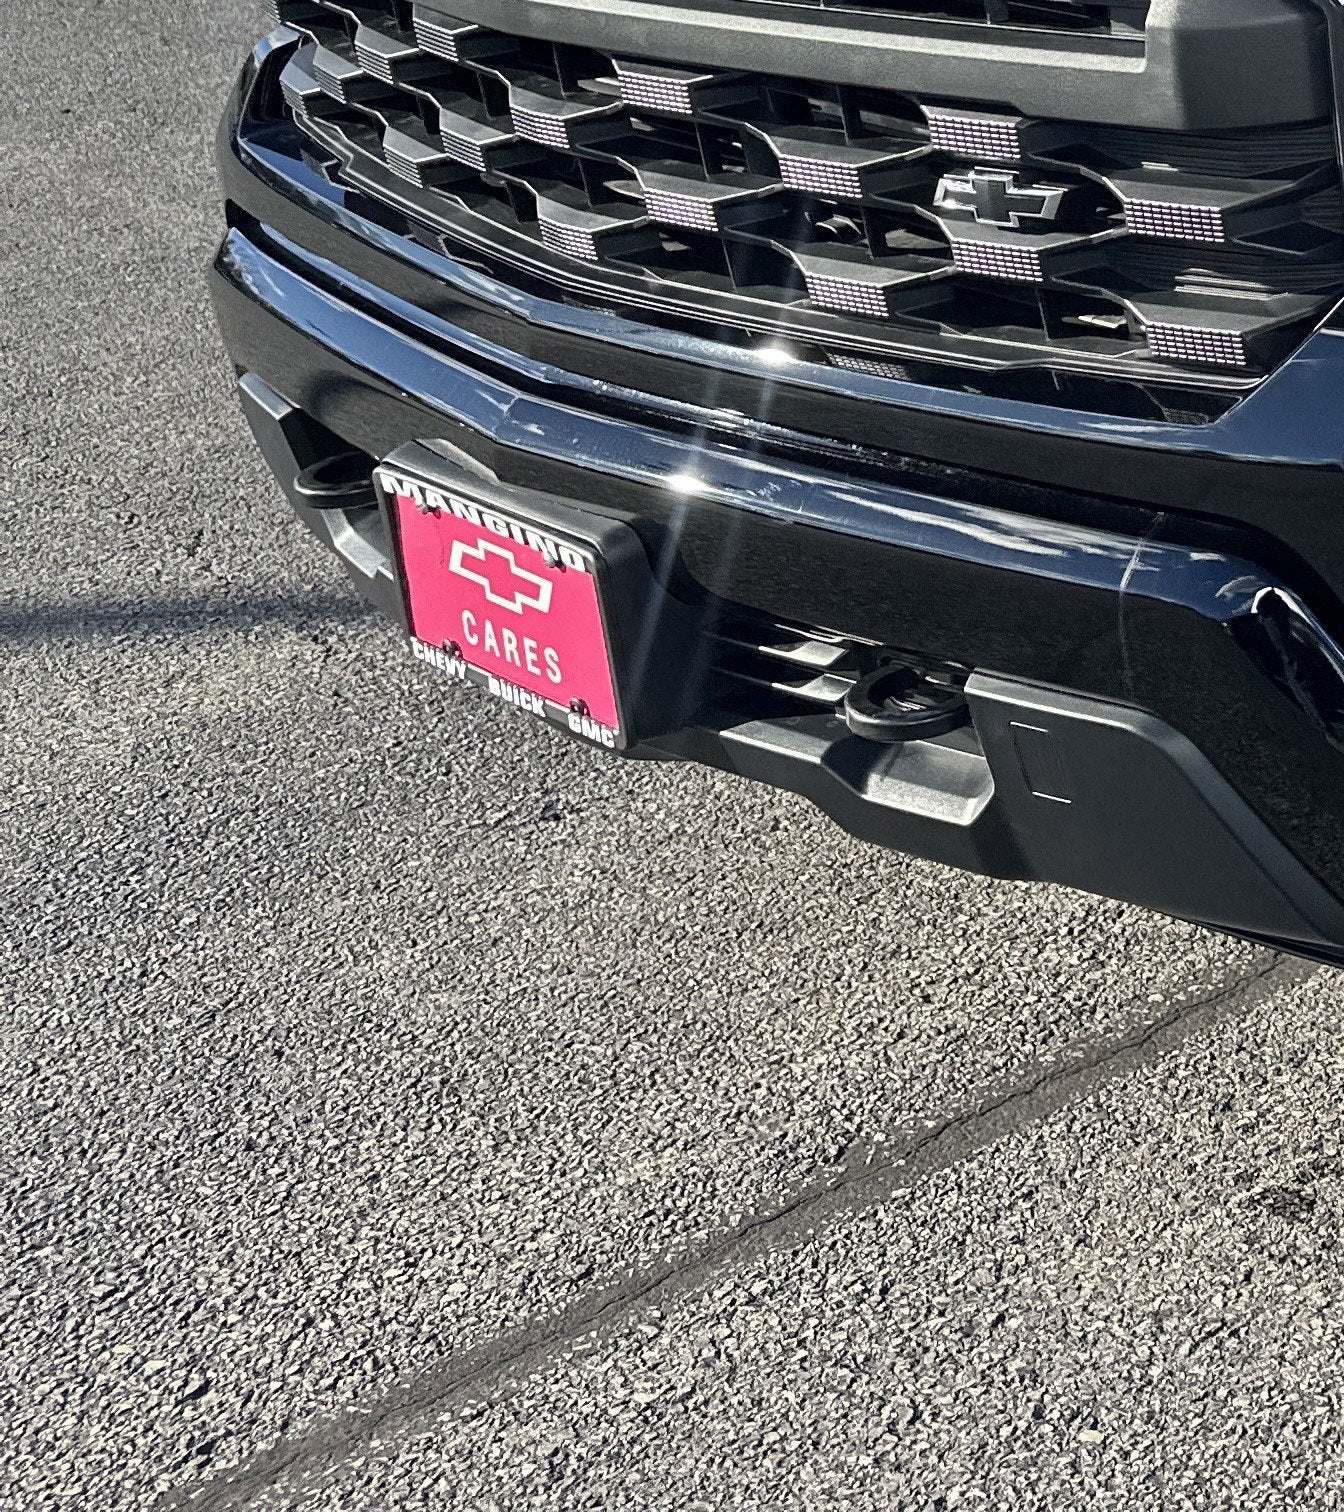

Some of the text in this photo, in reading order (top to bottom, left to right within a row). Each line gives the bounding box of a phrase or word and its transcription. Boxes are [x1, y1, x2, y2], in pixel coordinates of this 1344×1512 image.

[379, 473, 586, 573] MANGINO
[411, 637, 620, 749] CHEVY BUICK GMC
[461, 609, 562, 684] CARES
